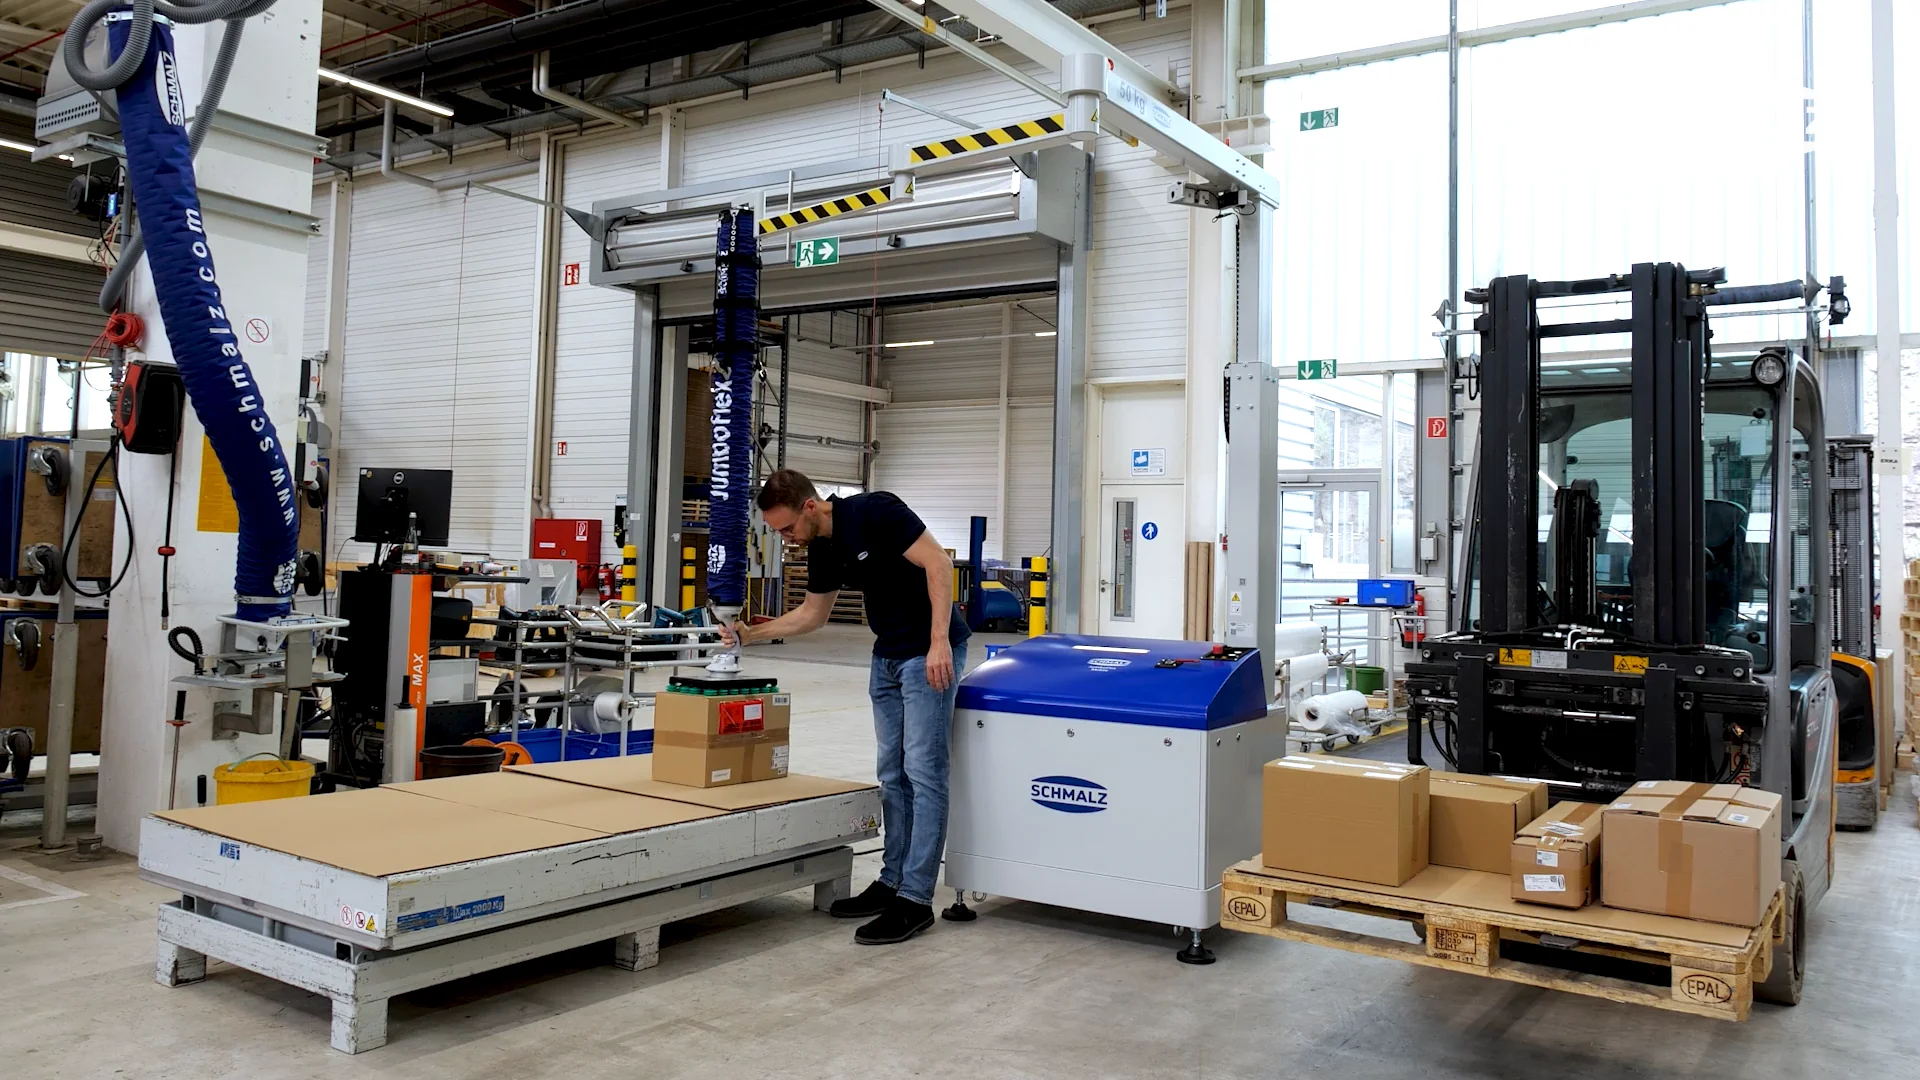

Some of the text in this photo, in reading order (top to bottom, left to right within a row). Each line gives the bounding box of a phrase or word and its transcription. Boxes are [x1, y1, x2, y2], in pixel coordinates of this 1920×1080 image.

[162, 51, 182, 127] SCHMALZ
[1119, 80, 1145, 116] 50 kg
[185, 207, 295, 526] www.schmalz.com
[412, 652, 424, 687] MAX
[1031, 784, 1108, 805] SCHMALZ
[1234, 900, 1261, 918] EPAL
[1687, 979, 1726, 1000] EPAL
